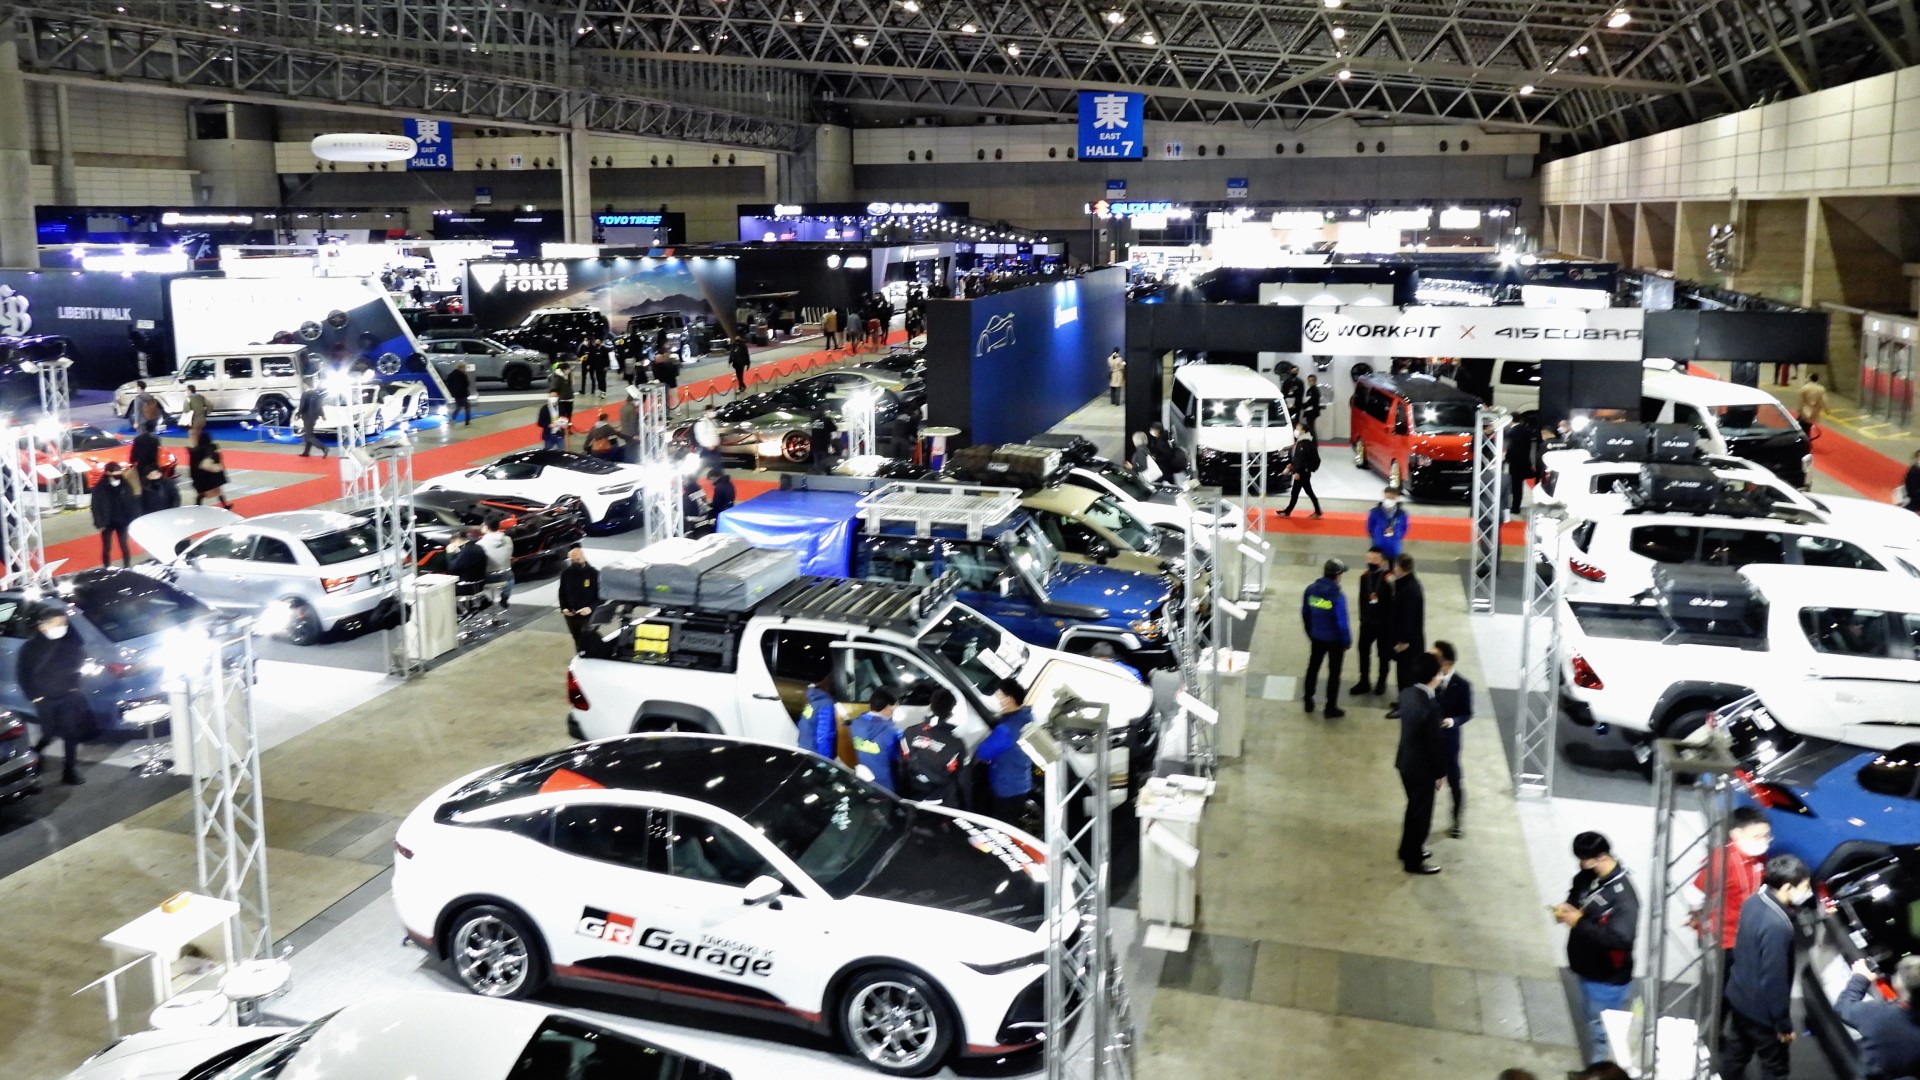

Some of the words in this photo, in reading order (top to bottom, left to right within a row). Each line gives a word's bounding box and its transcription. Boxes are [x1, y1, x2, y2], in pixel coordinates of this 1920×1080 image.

[1093, 94, 1129, 130] 東
[386, 139, 411, 151] BBS
[1086, 145, 1119, 157] HALL
[1121, 141, 1135, 156] 7
[412, 158, 436, 167] HALL
[437, 153, 448, 167] 8
[890, 203, 939, 214] SUBARU
[1110, 202, 1172, 215] SUZUKI
[598, 215, 628, 225] TOYO
[629, 215, 663, 225] TIRES
[505, 263, 568, 277] DELTA
[506, 278, 569, 292] FORCE
[57, 306, 101, 320] LIBERTY
[101, 307, 132, 321] WALK
[1337, 324, 1441, 338] WORKPIT
[578, 915, 634, 945] GR
[638, 926, 776, 977] Garage
[699, 933, 760, 956] TAKASAKI
